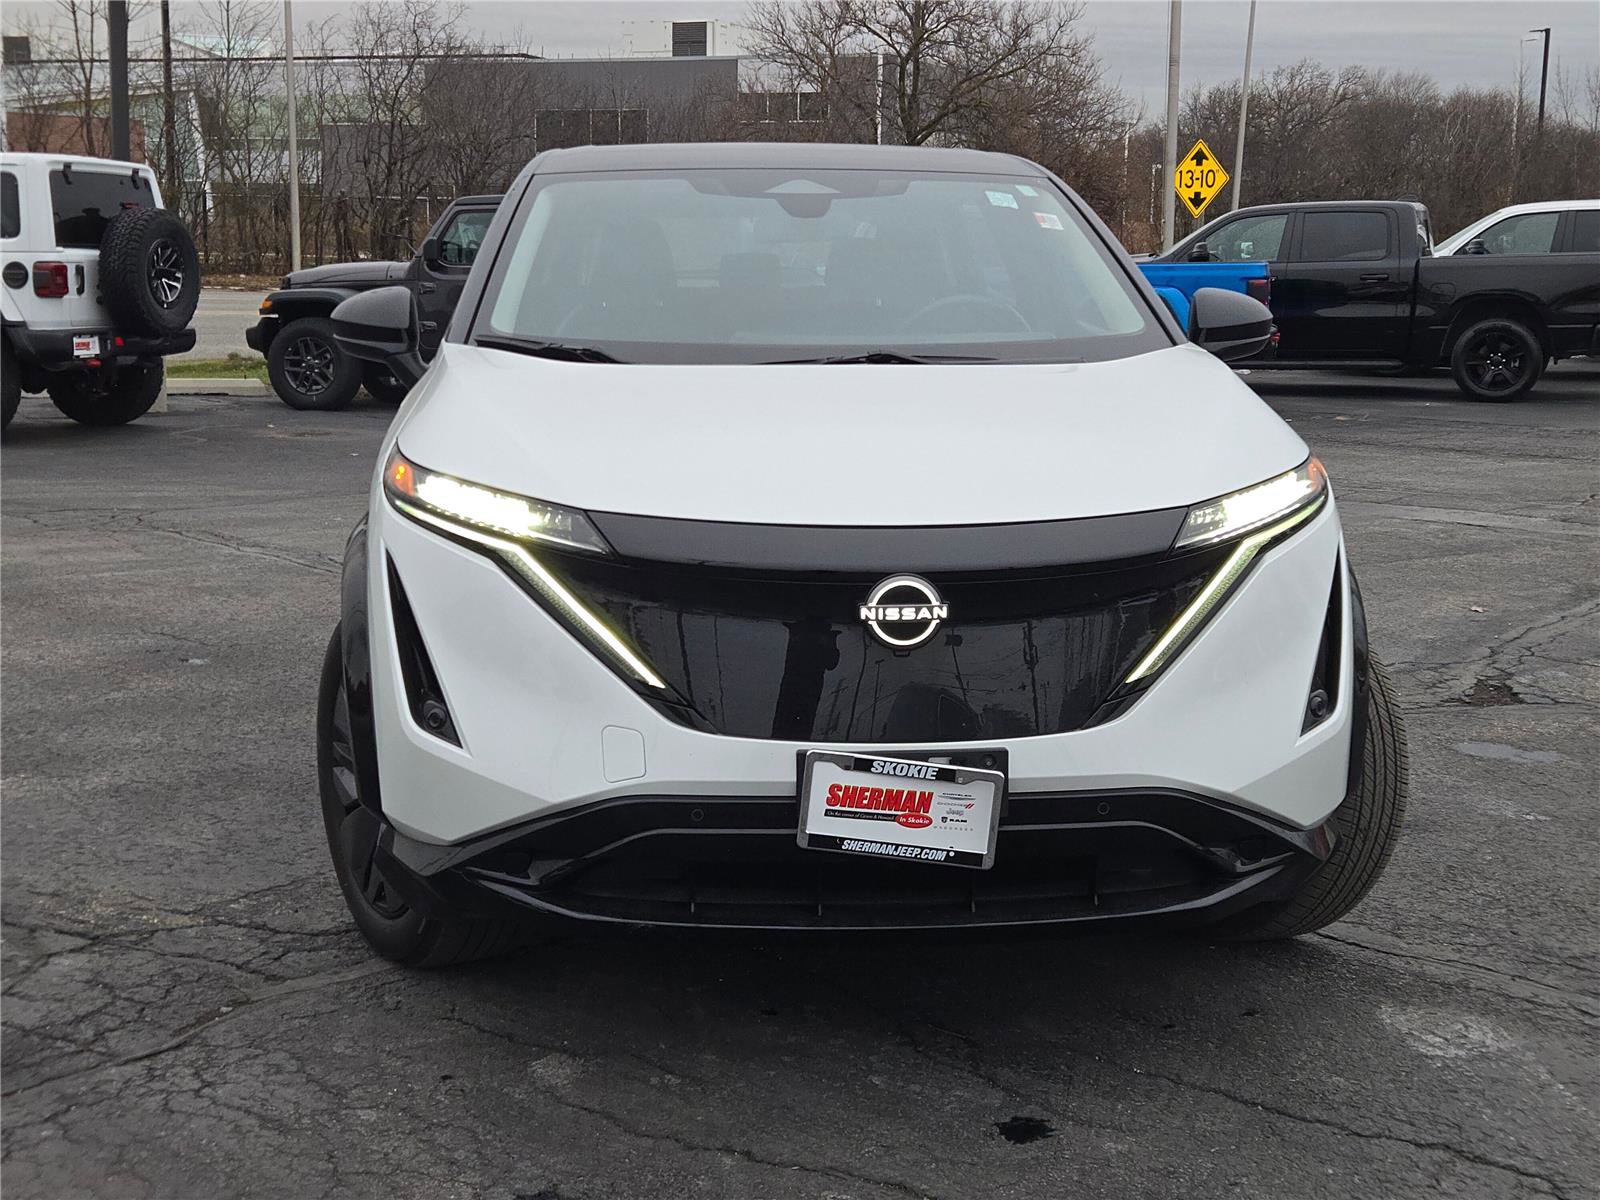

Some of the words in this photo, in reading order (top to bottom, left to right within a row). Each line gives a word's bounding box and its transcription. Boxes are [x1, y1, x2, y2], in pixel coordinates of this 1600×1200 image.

[860, 606, 947, 620] NISSAN
[870, 760, 939, 780] SKOKIE
[826, 783, 934, 814] SHERMAN
[907, 817, 930, 825] Skokie
[841, 840, 947, 861] SHERMANJEEP.COM
